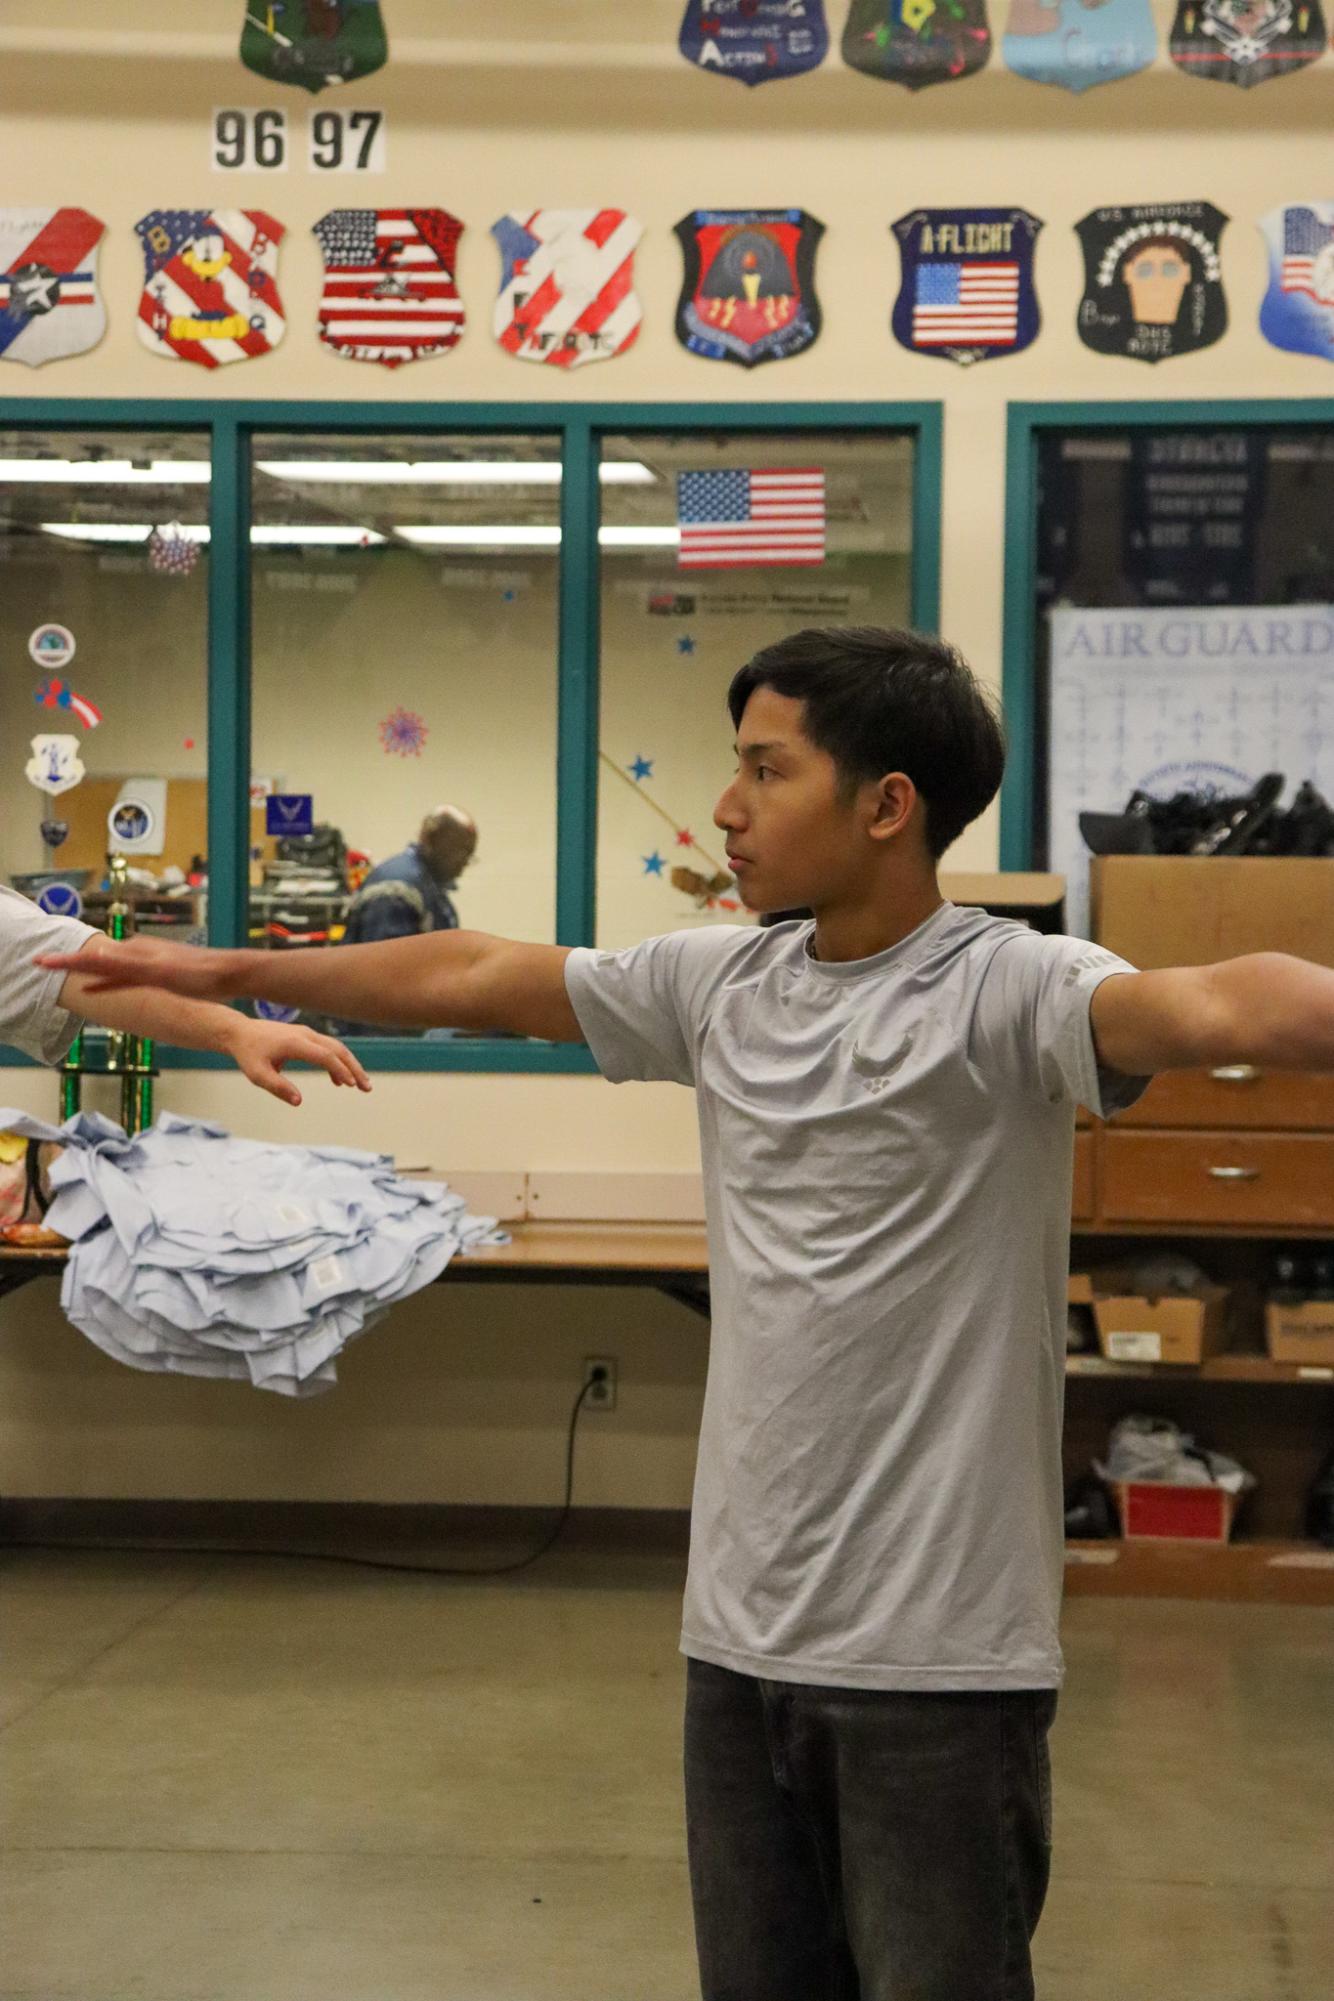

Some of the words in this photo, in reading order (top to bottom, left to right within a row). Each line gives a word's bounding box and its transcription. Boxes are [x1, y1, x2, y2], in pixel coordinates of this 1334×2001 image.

[216, 110, 284, 168] 96
[312, 111, 382, 168] 97
[1065, 621, 1149, 657] AIR
[1159, 619, 1334, 657] GUARD
